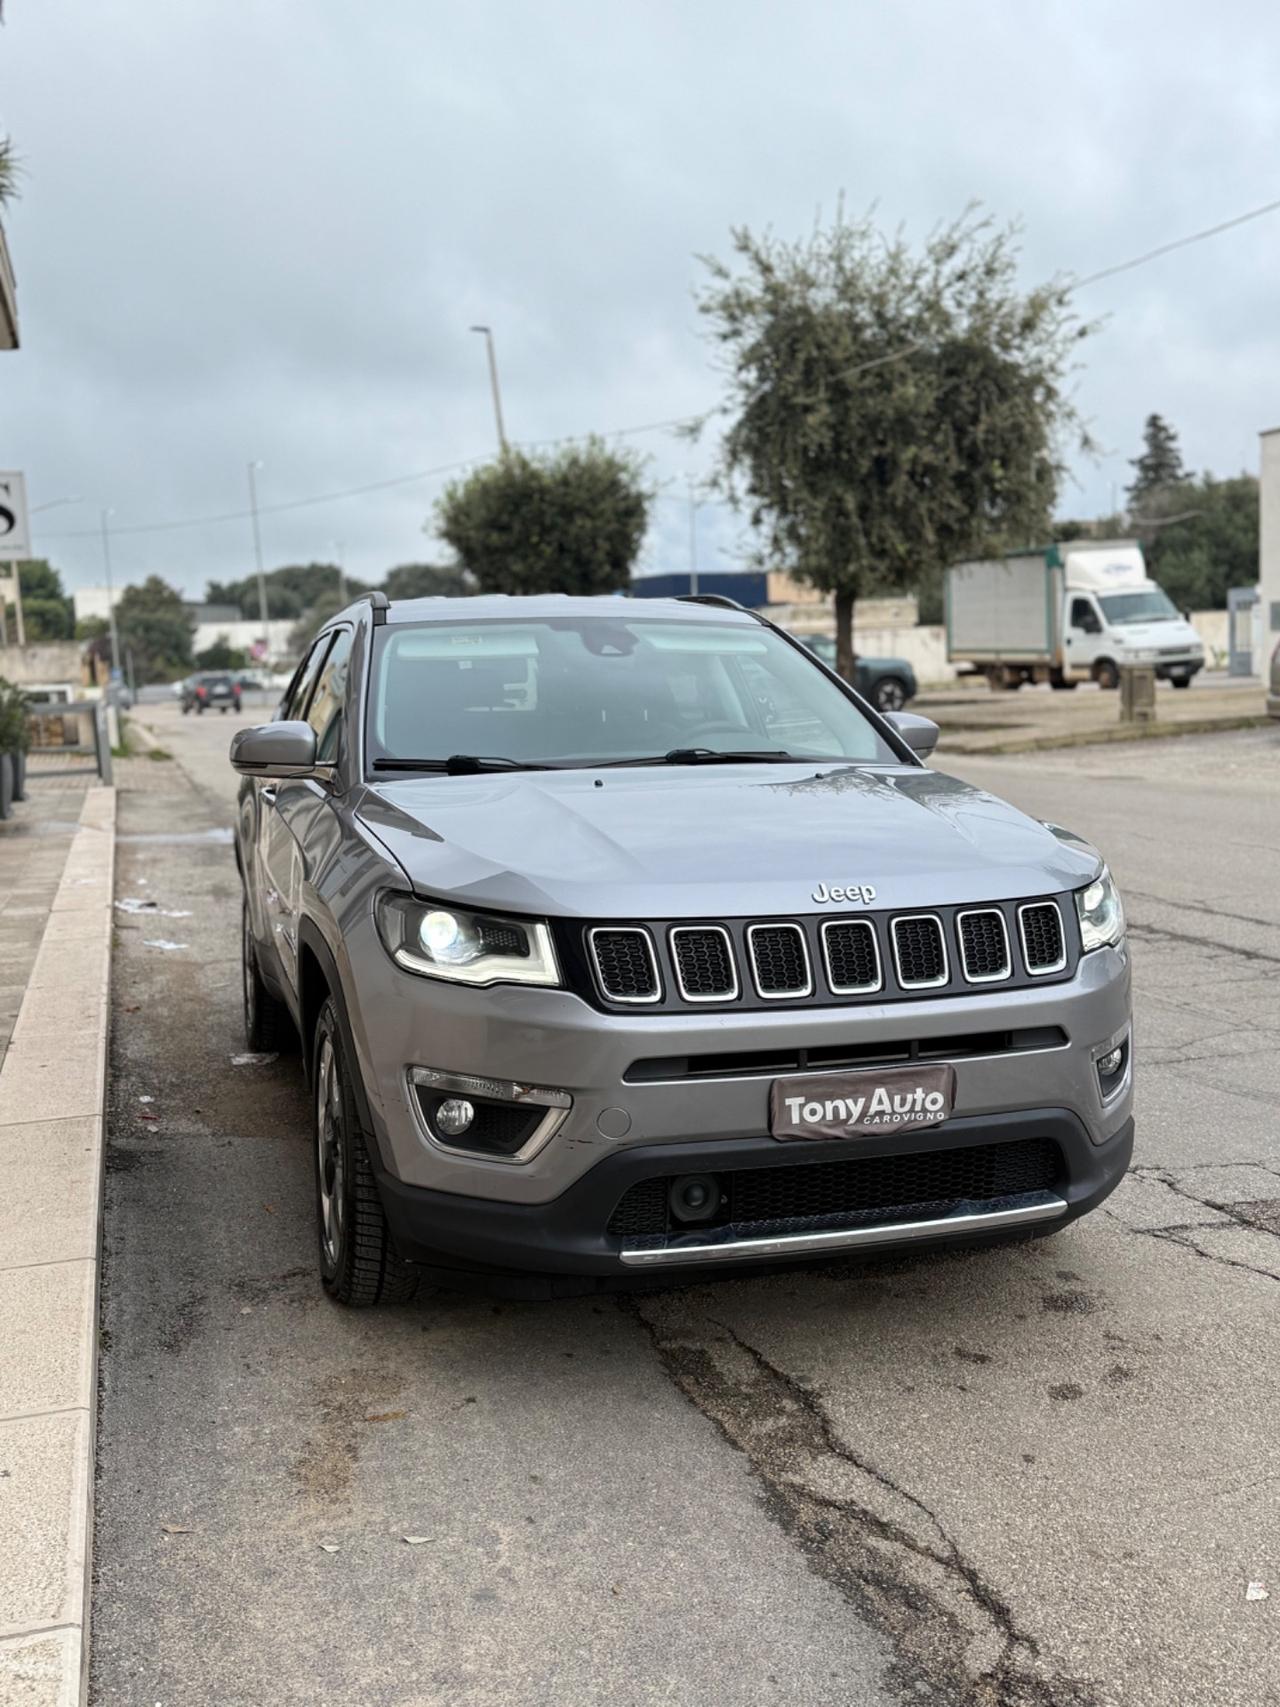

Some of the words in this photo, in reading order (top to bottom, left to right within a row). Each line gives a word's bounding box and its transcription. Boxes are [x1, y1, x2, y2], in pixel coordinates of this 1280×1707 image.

[811, 883, 876, 905] Jeep
[785, 1096, 866, 1125] Tony
[867, 1087, 945, 1116] Auto
[863, 1111, 945, 1125] CAROVIGNO
